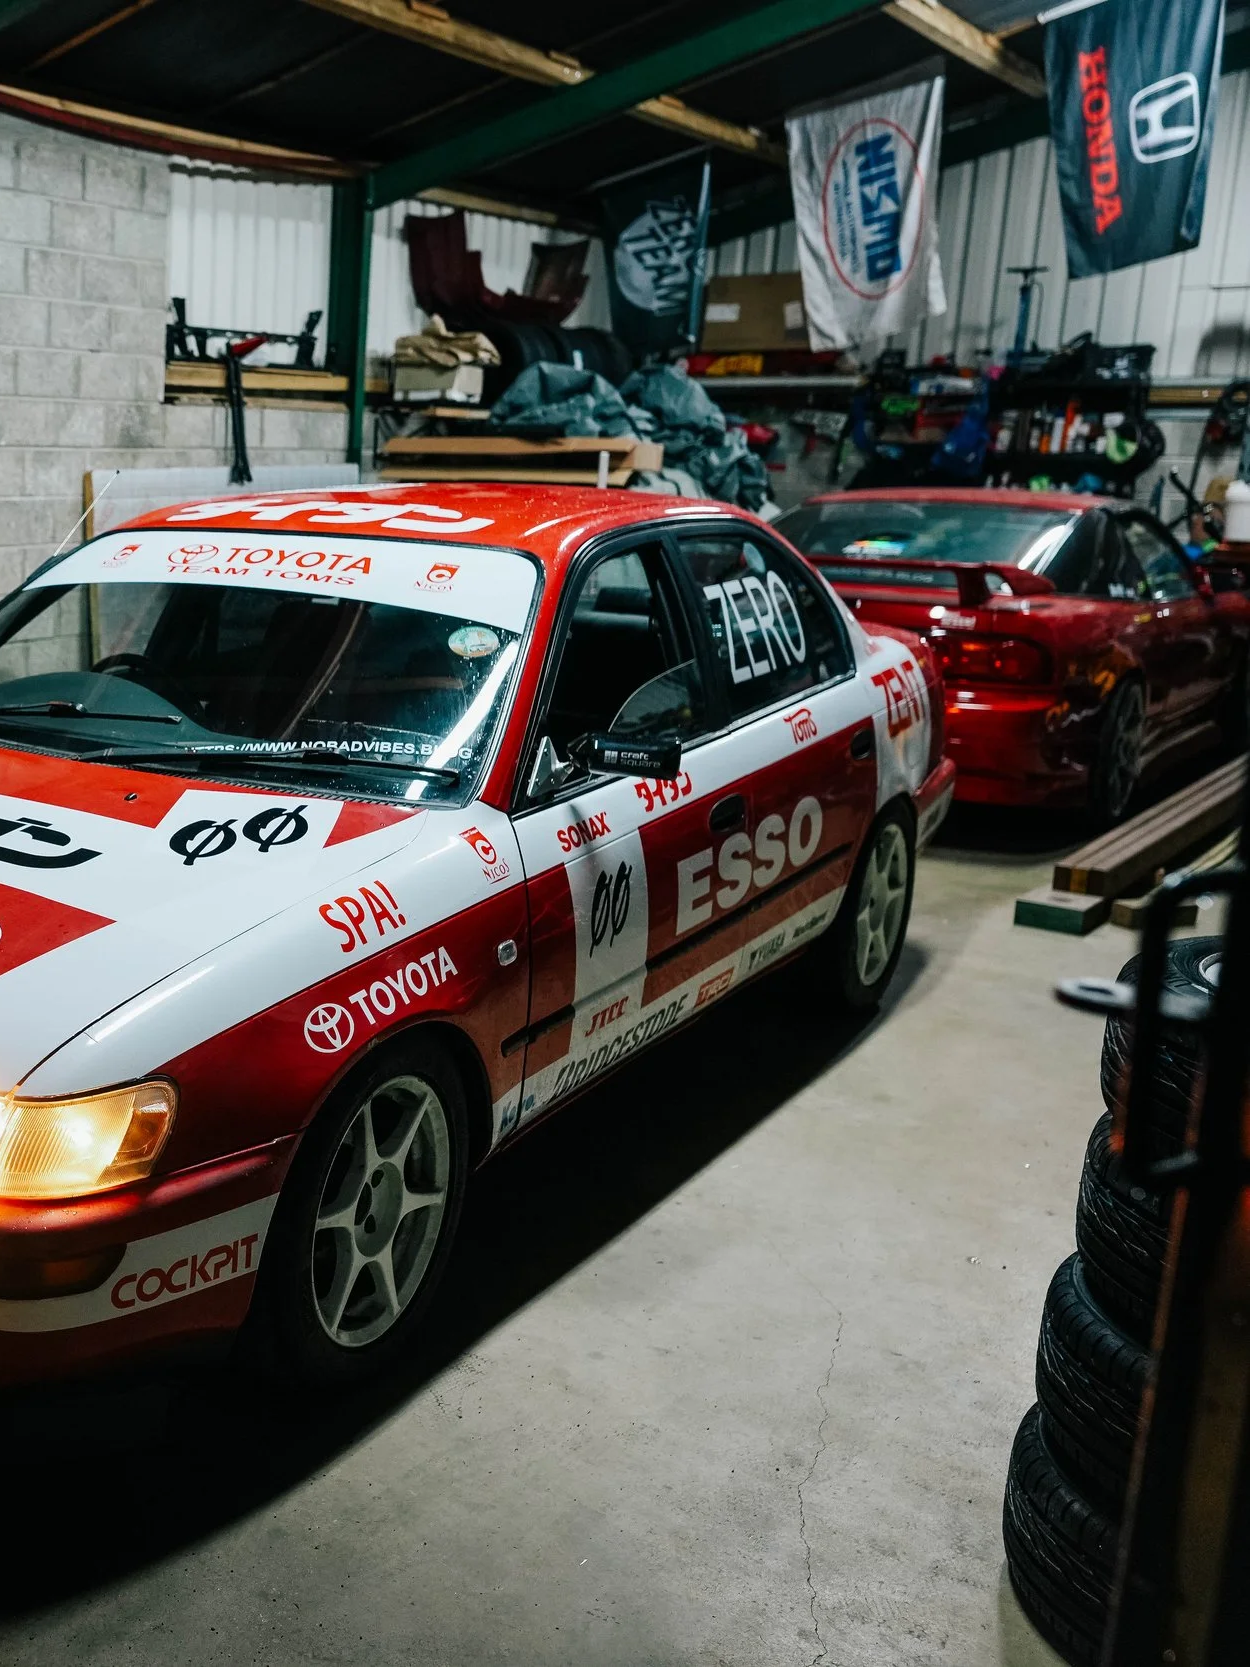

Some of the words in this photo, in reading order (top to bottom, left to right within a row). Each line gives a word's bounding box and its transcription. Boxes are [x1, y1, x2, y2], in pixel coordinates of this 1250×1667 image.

[1077, 45, 1124, 235] HONDA
[855, 133, 902, 283] NISMO
[166, 564, 250, 578] TEAM
[261, 569, 357, 587] TOMS
[226, 547, 372, 575] TOYOTA
[703, 570, 806, 685] ZERO
[620, 759, 661, 769] square
[556, 812, 612, 852] SONAX
[676, 795, 823, 936] ESSO
[318, 880, 407, 953] SPA!
[348, 946, 459, 1025] TOYOTA
[585, 995, 631, 1037] JTCC
[111, 1233, 258, 1310] COCKPIT
